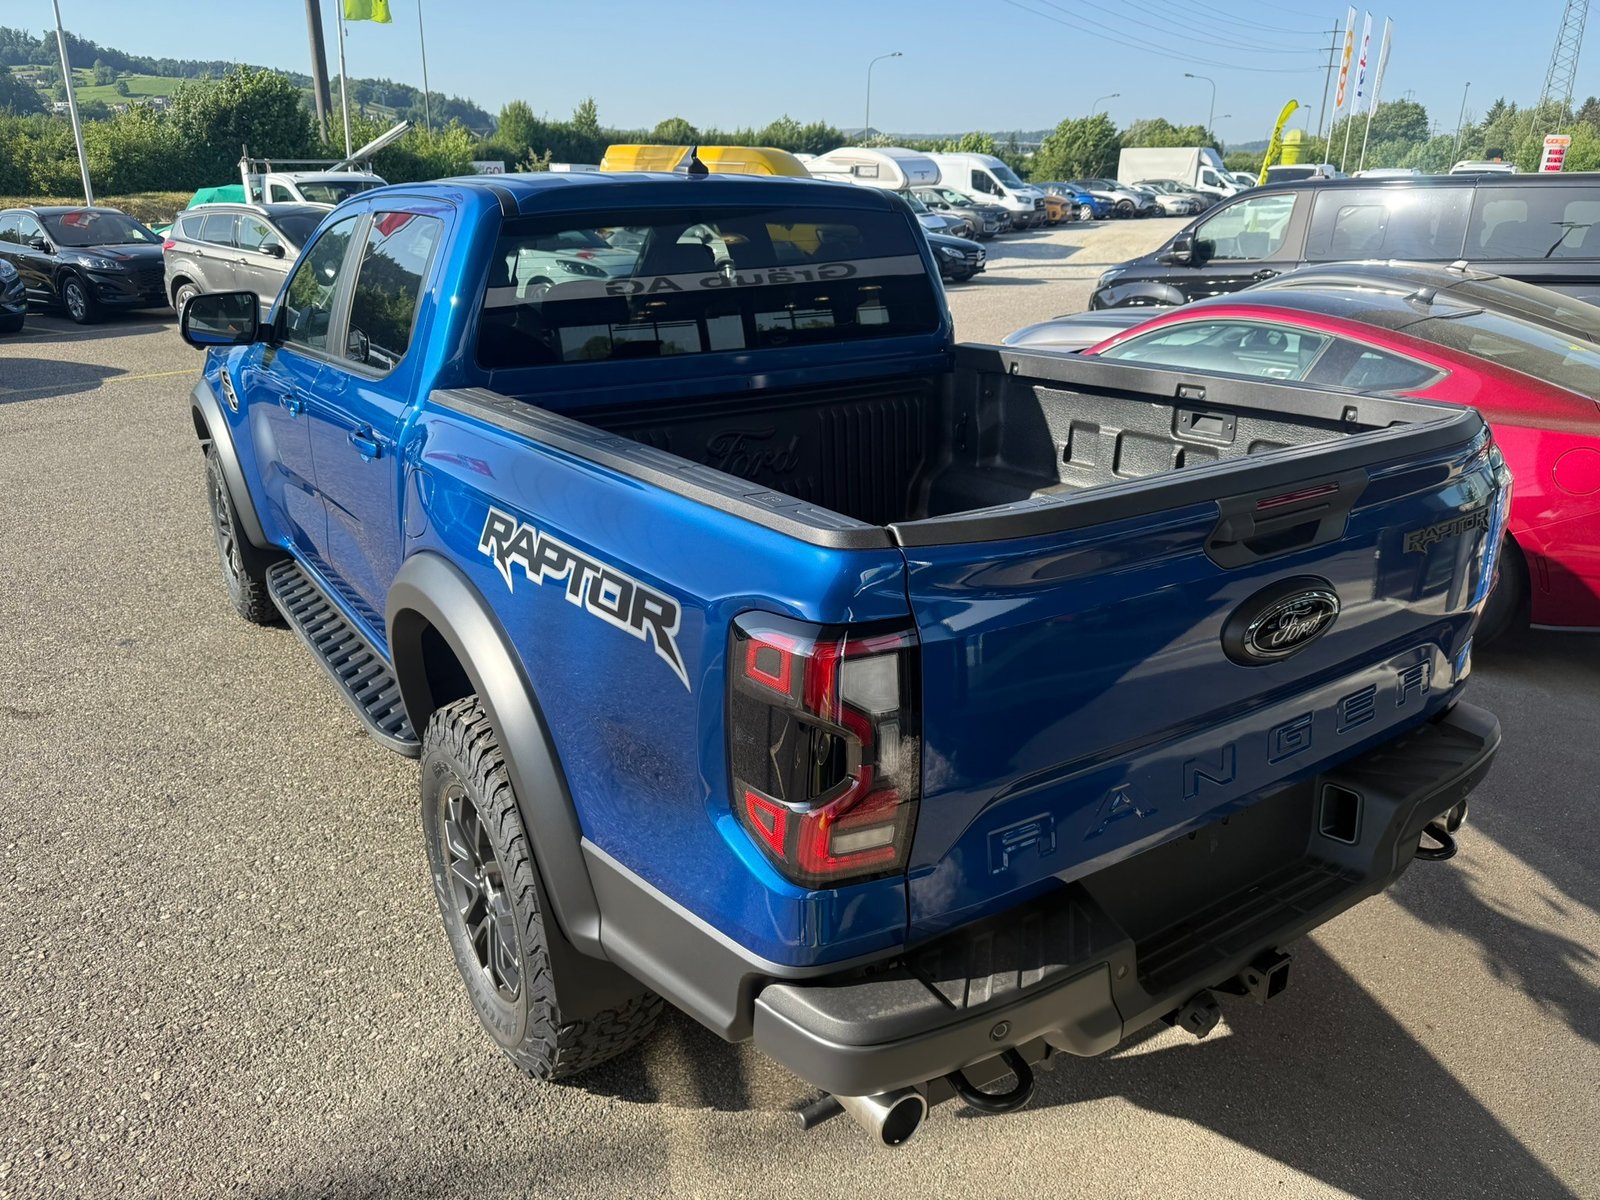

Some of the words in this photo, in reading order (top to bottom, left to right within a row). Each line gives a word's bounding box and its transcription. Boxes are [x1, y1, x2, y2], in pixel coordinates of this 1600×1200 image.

[705, 425, 800, 477] Ford
[1403, 506, 1490, 554] RAPTOR
[478, 505, 691, 694] RAPTOR
[1271, 606, 1323, 644] Ford
[987, 658, 1432, 876] RANGER
